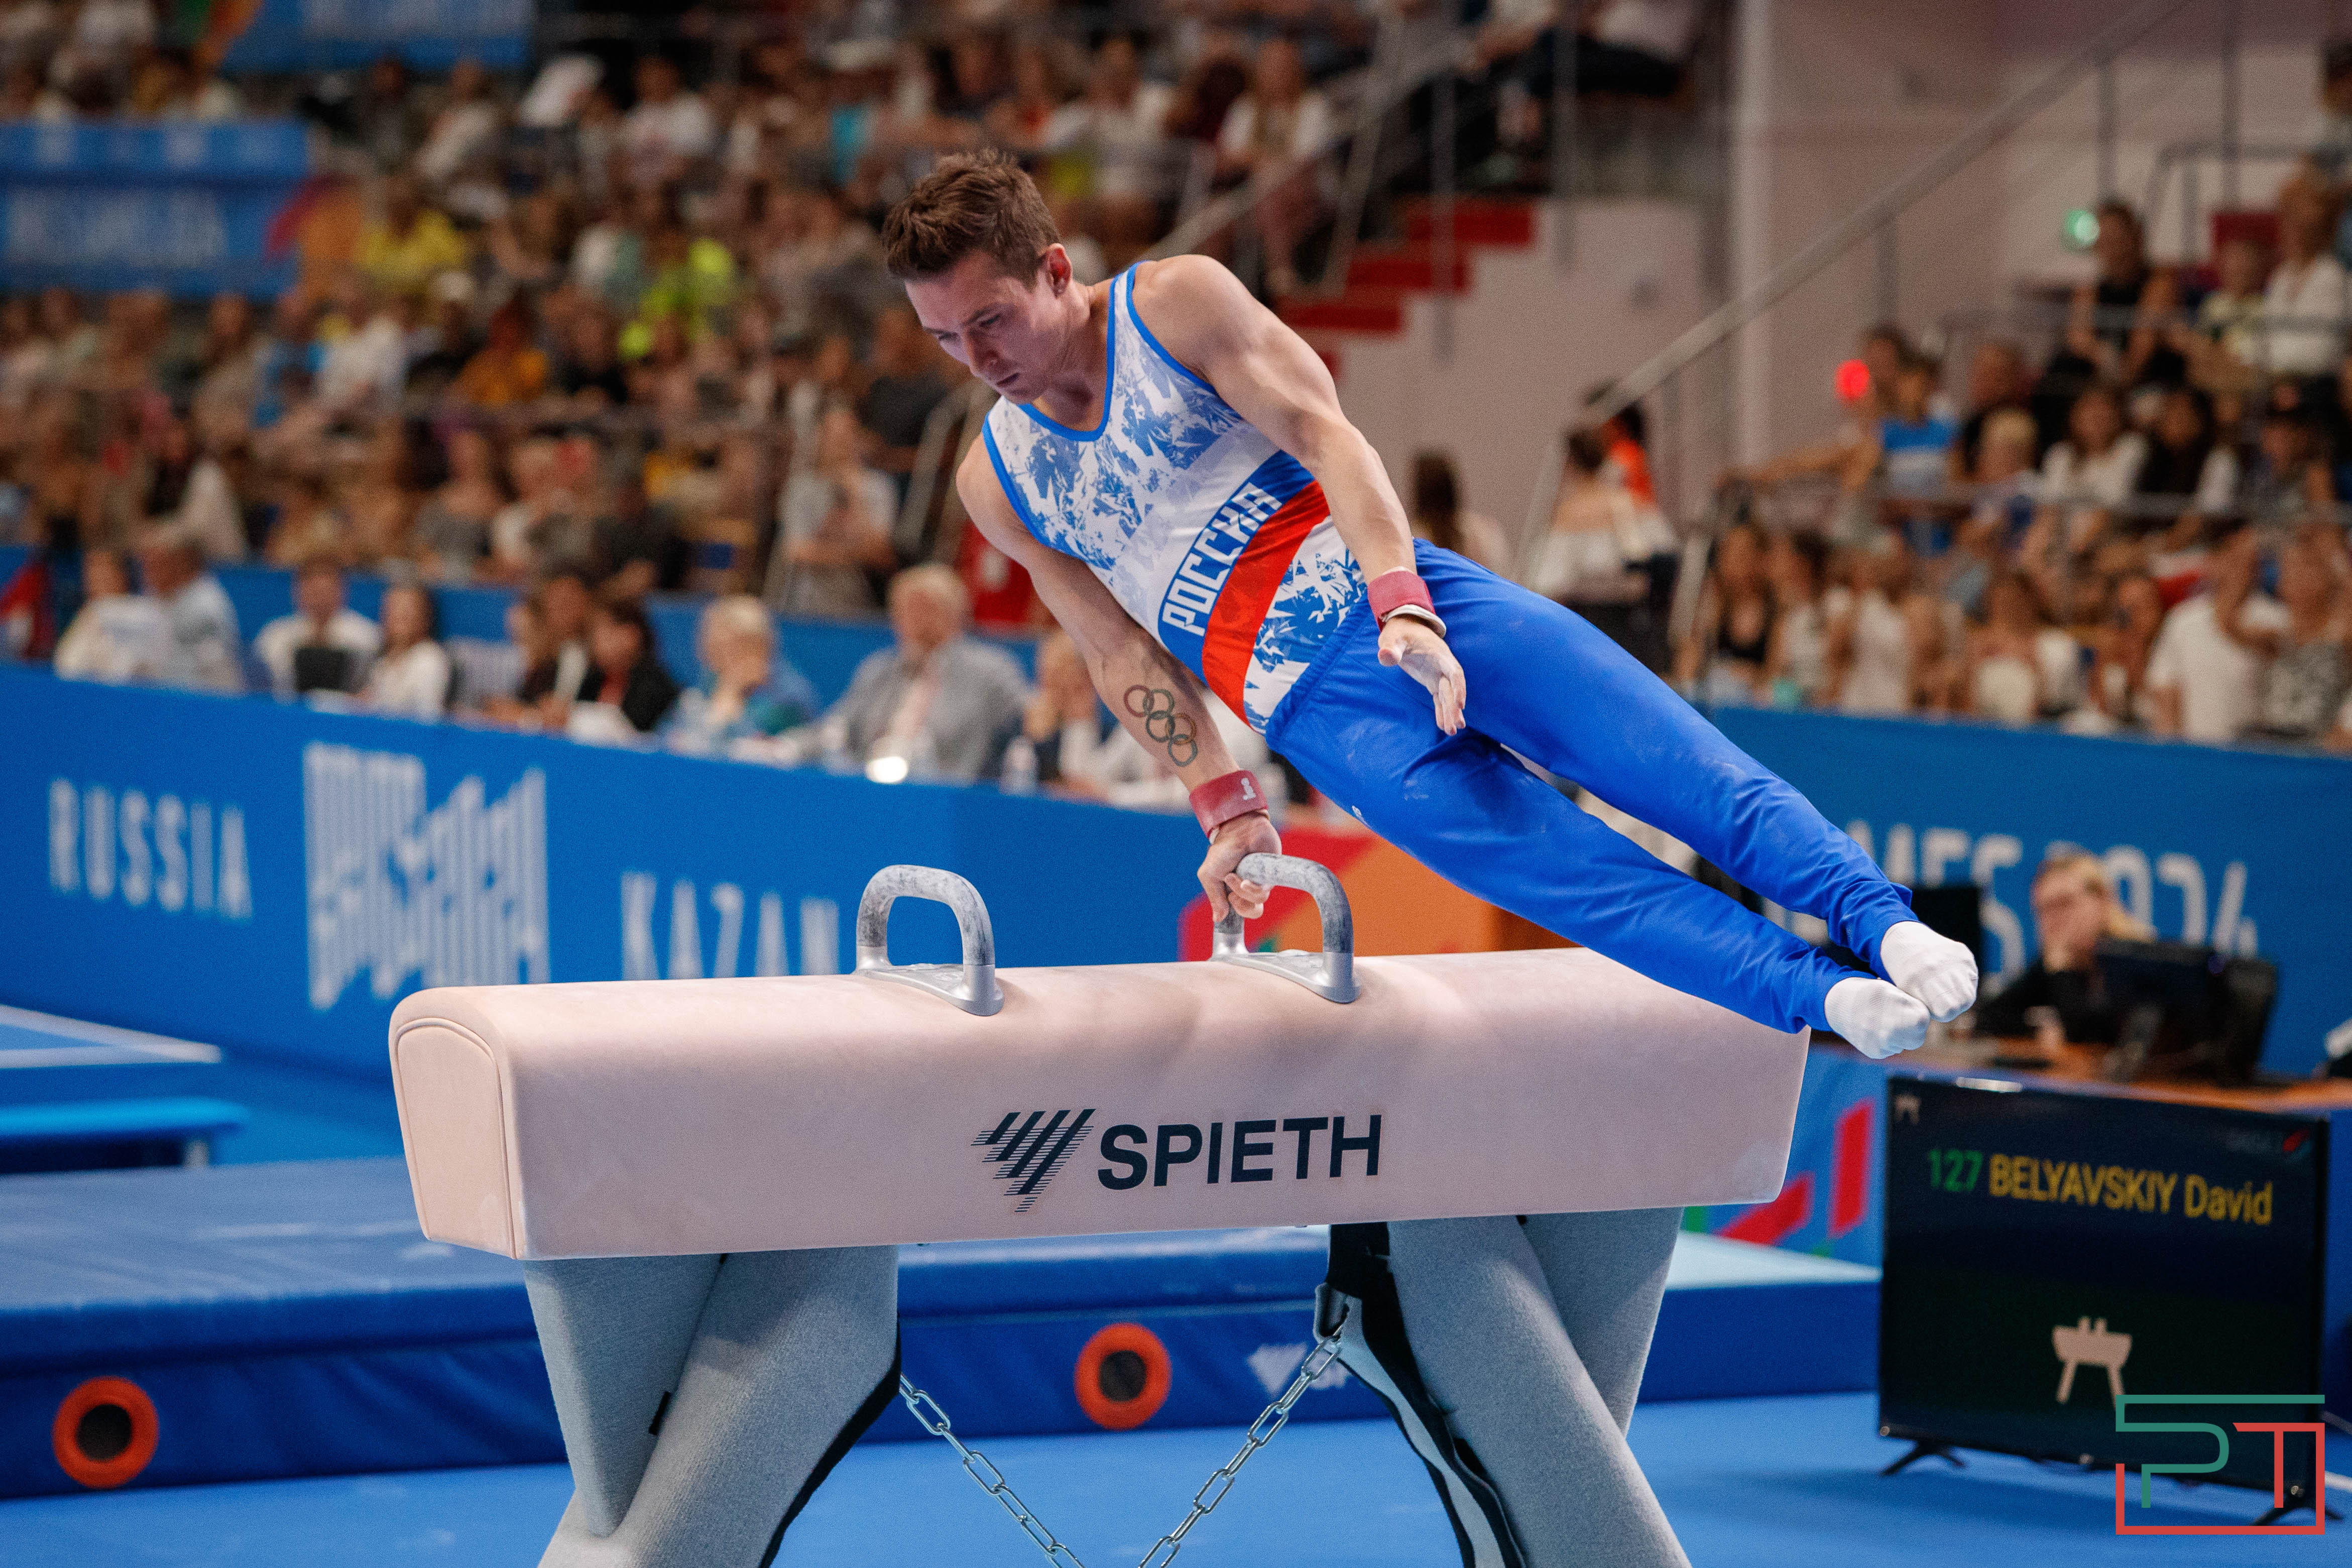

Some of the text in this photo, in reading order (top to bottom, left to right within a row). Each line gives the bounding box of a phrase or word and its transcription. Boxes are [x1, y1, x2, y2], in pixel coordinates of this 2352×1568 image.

[1161, 482, 1282, 637] РОССИЯ
[49, 777, 253, 919] RUSSIA
[621, 870, 840, 980] KAZAN
[1097, 1114, 1382, 1191] SPIETH
[1929, 1149, 2273, 1226] 127 BELYAVSKIY David
